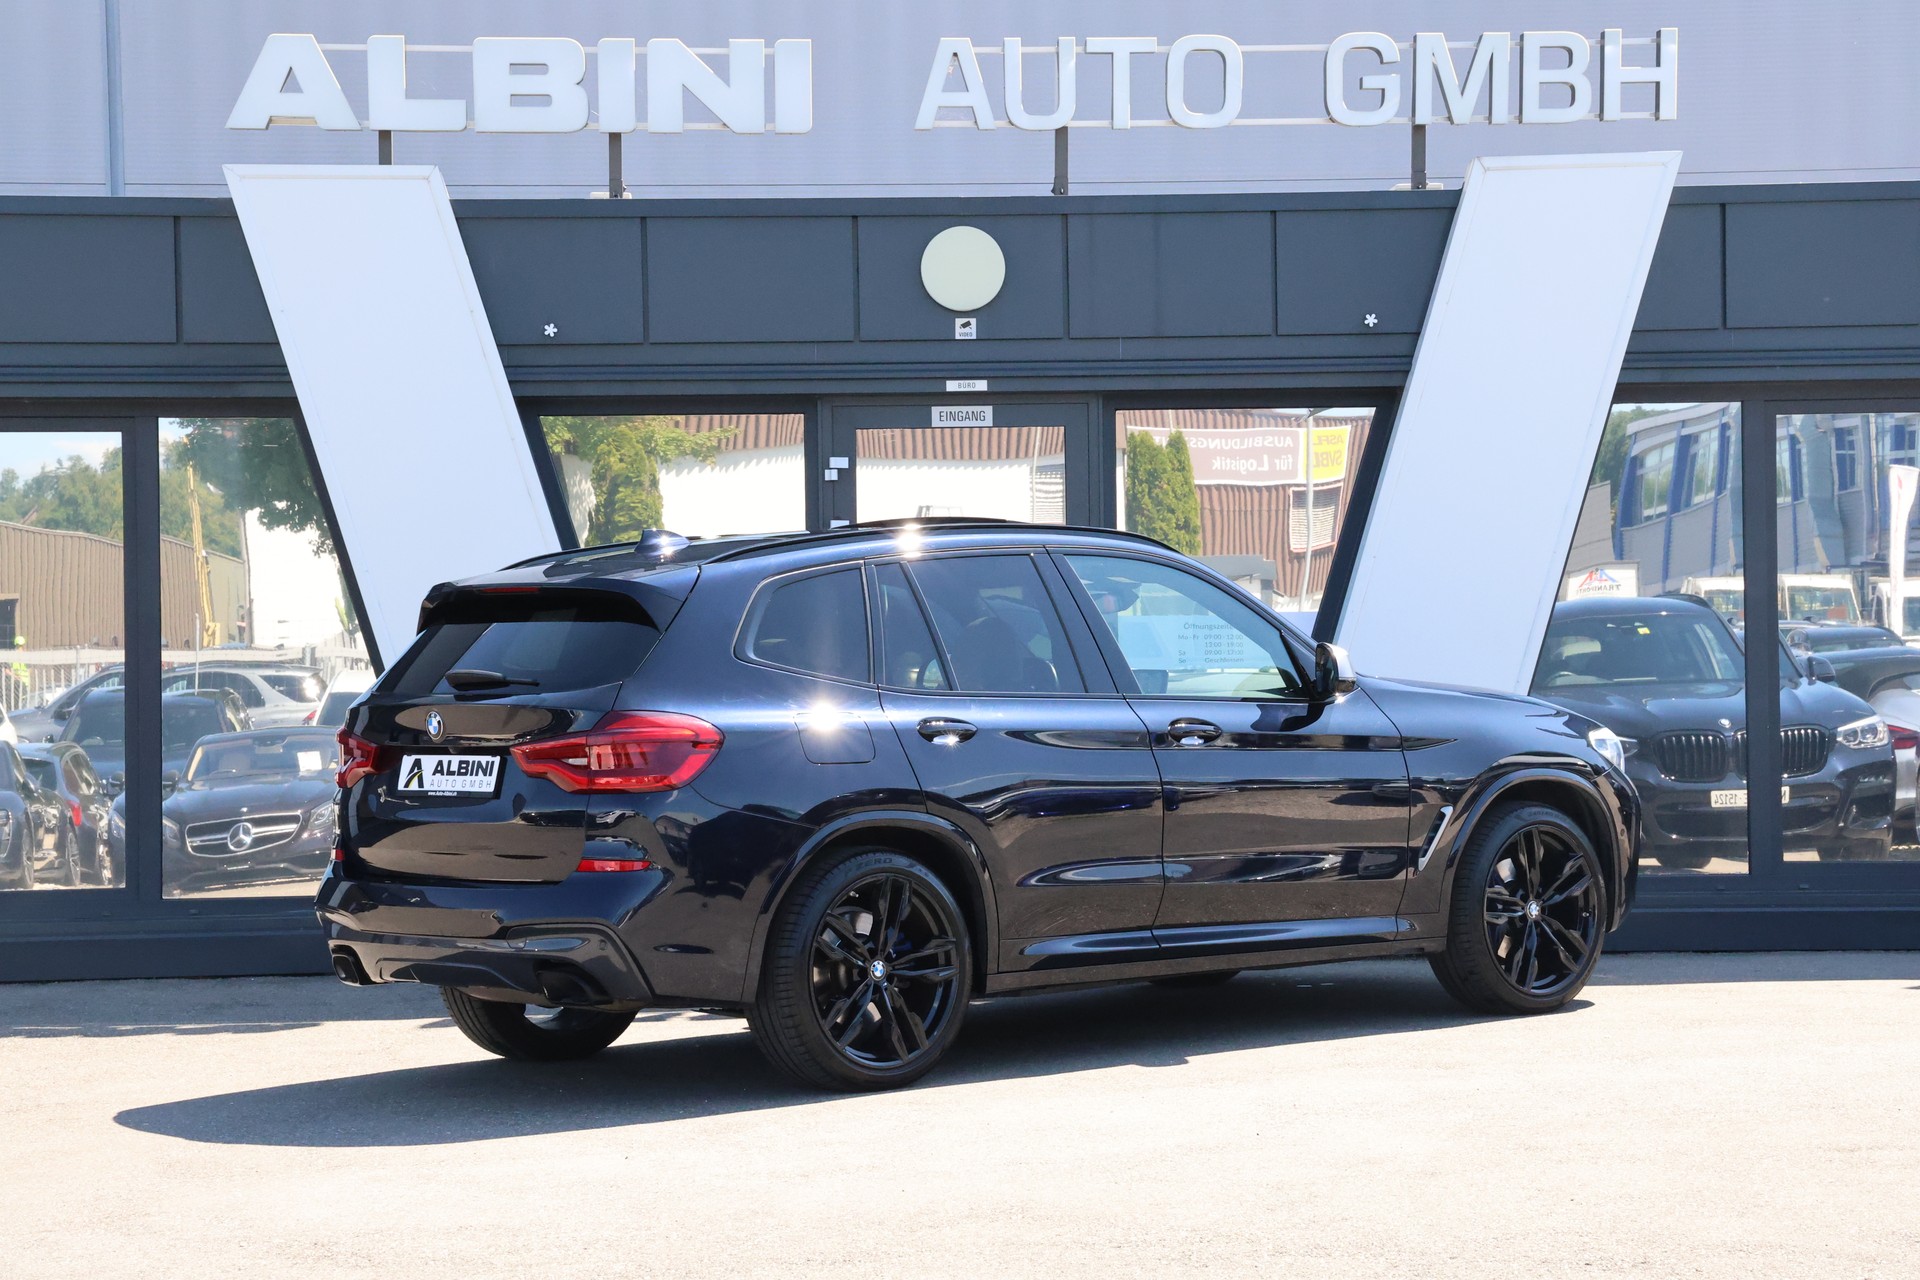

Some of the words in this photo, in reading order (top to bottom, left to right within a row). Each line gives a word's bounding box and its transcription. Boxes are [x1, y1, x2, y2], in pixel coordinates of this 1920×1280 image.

[225, 33, 813, 134] ALBINI
[914, 34, 1243, 132] AUTO
[1323, 27, 1679, 127] GMBH
[957, 381, 976, 389] BÜRO
[939, 410, 986, 422] EINGANG
[431, 759, 495, 777] ALBINI
[430, 779, 457, 788] AUTO
[461, 780, 492, 789] GMBH
